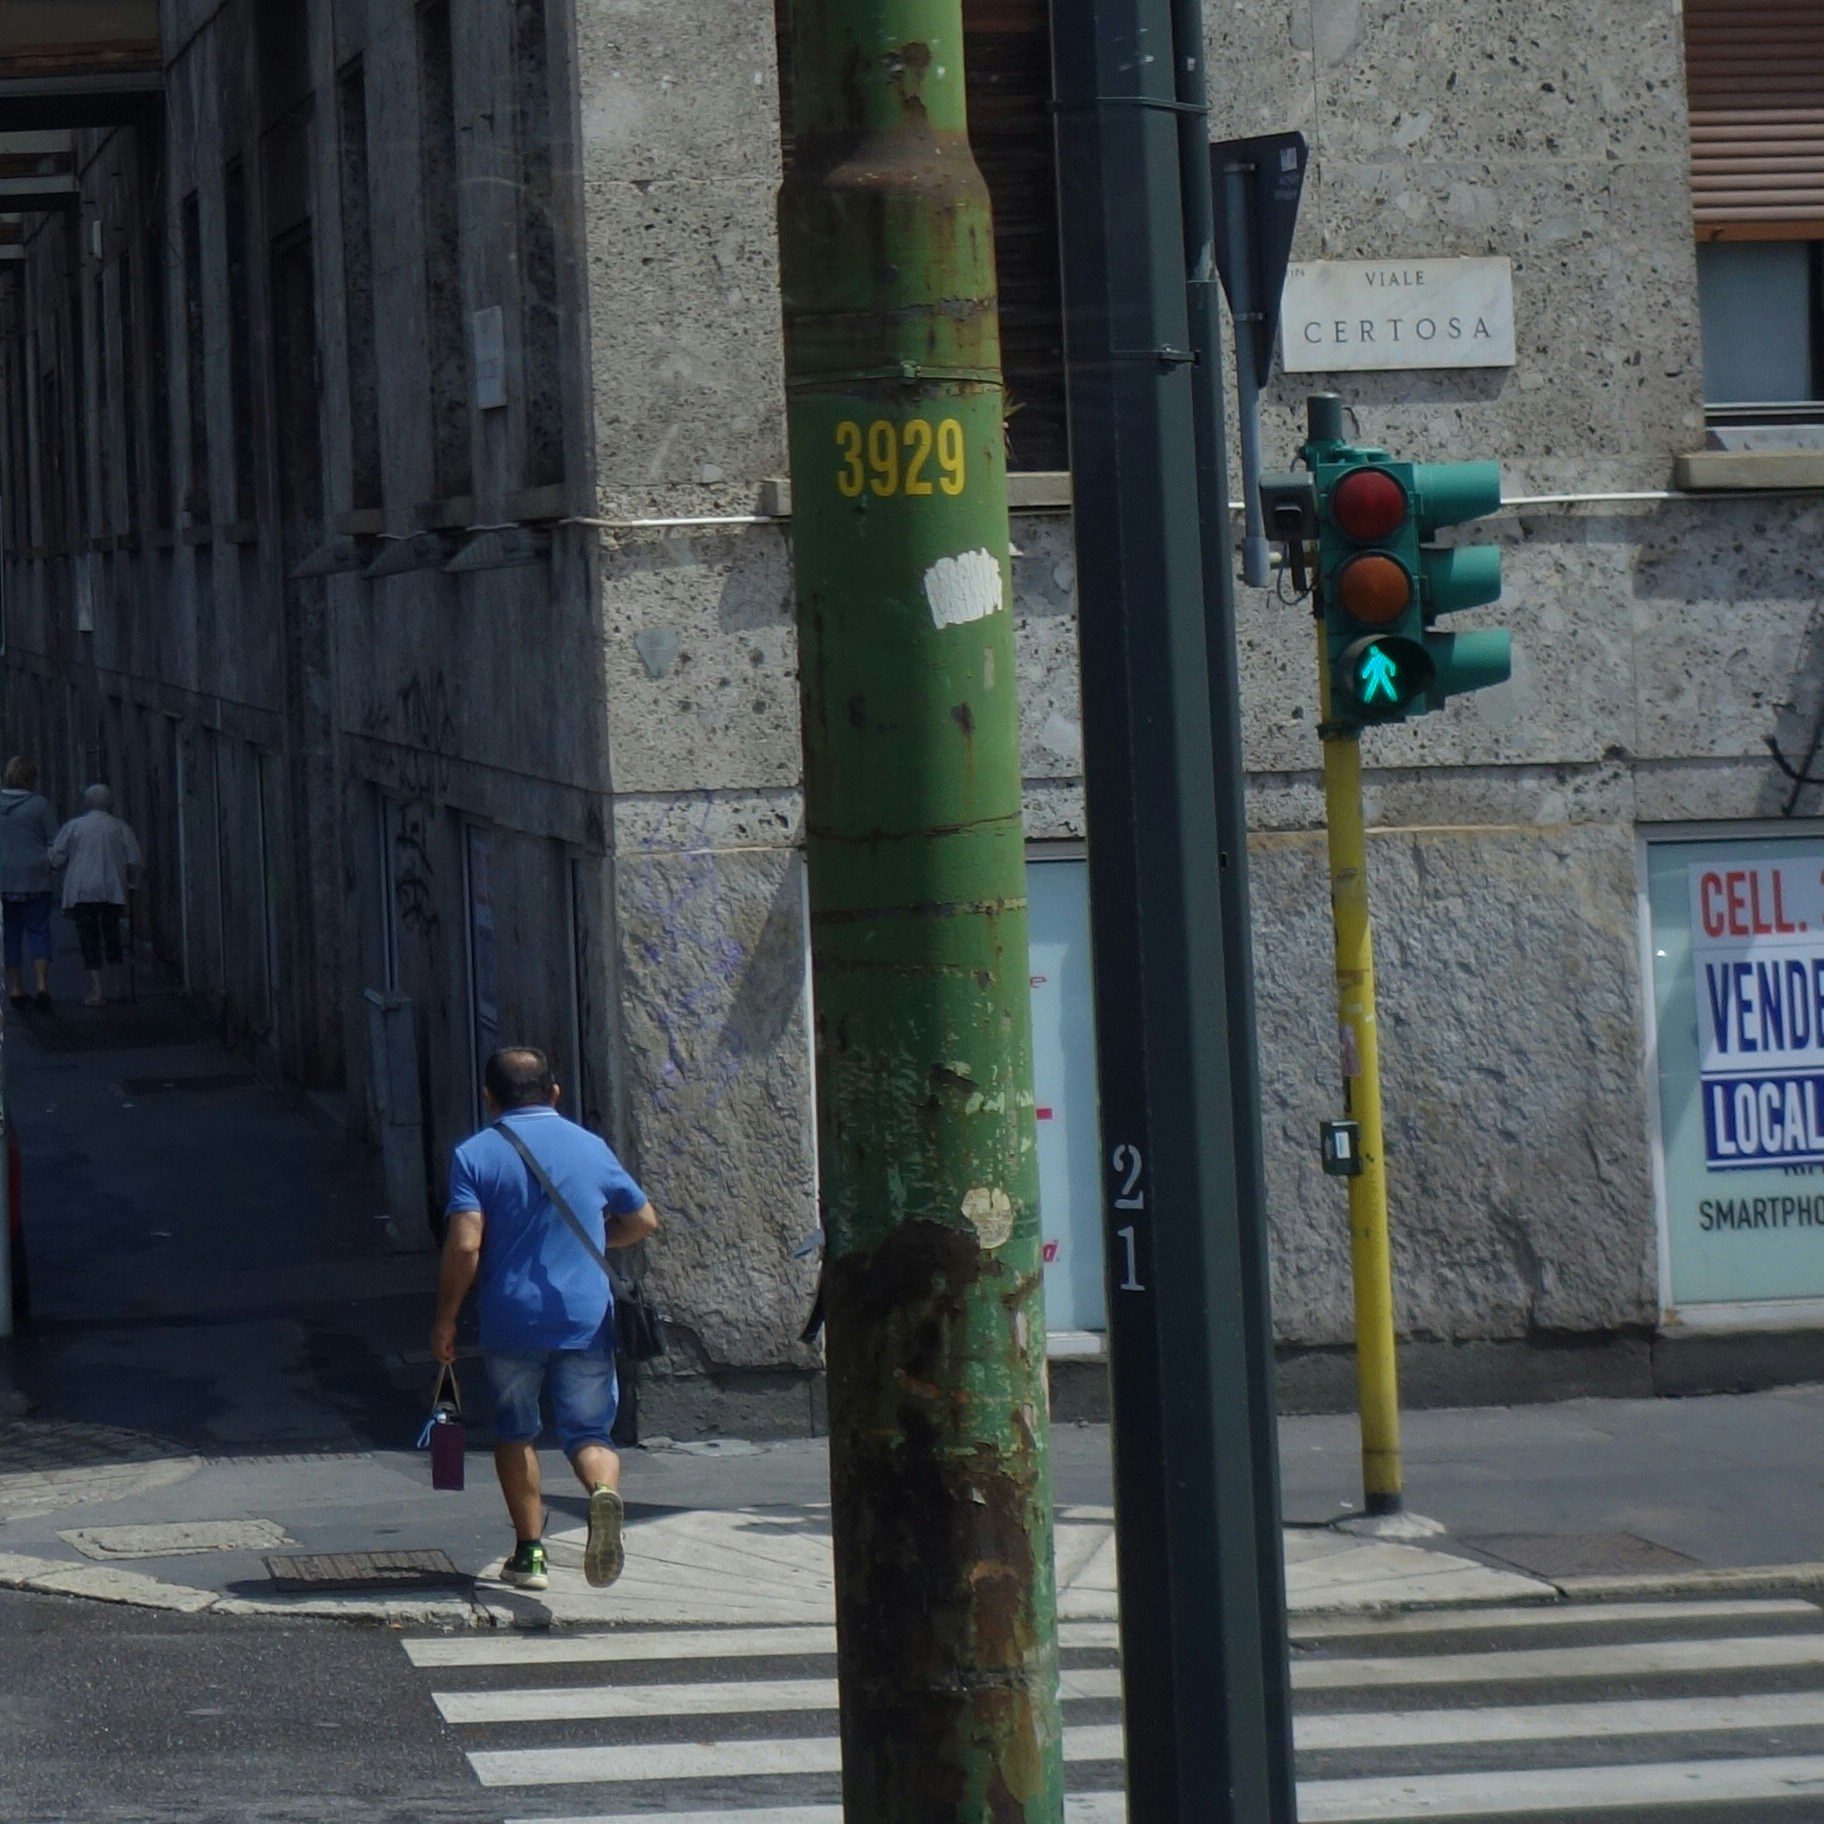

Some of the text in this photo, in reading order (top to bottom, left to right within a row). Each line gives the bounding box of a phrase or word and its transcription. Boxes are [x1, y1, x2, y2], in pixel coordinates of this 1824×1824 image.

[1365, 271, 1426, 288] VIALE
[1304, 317, 1492, 345] CERTOSA
[835, 418, 965, 497] 3929
[1701, 869, 1807, 938] CELL.
